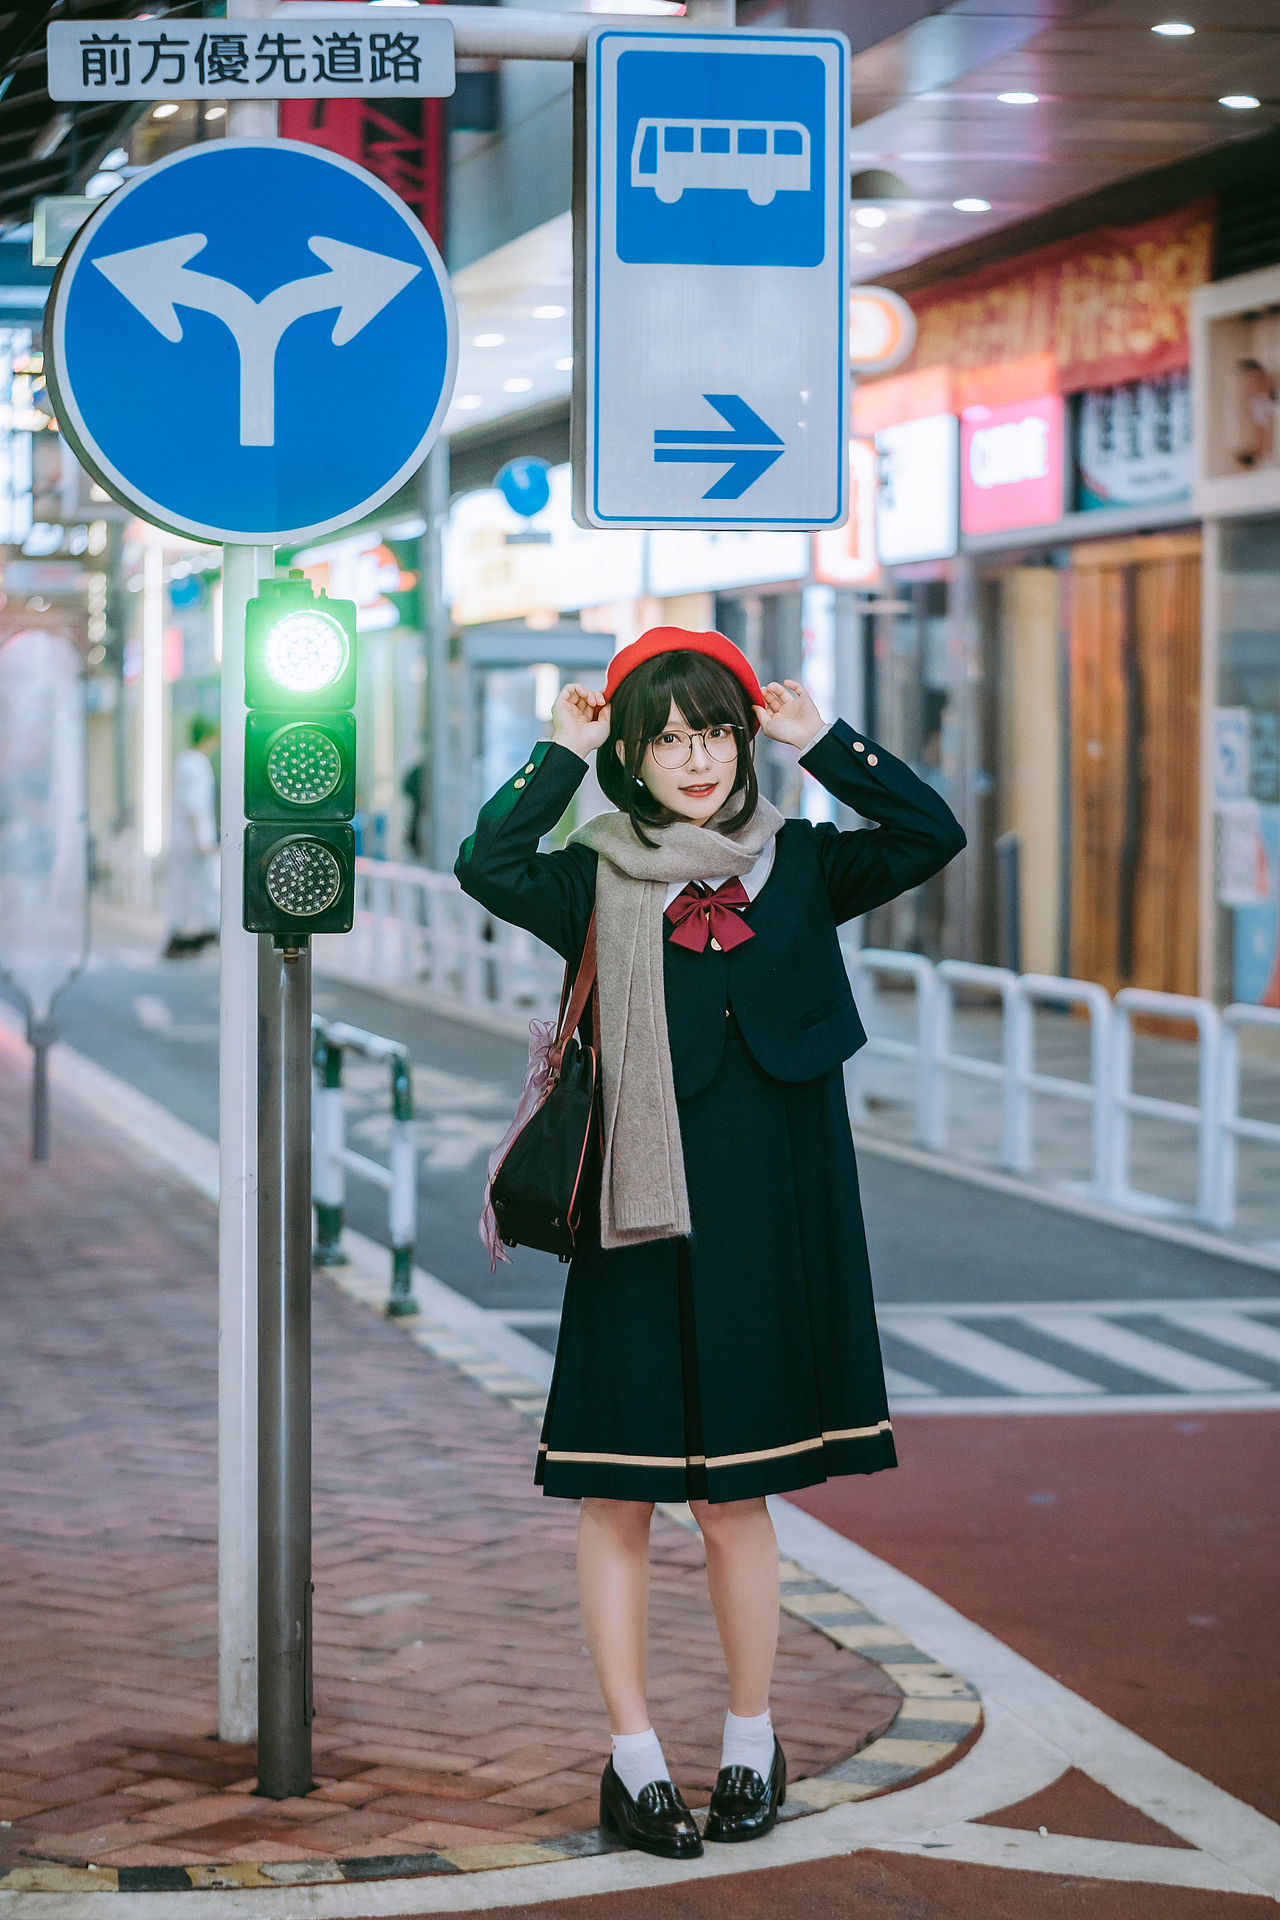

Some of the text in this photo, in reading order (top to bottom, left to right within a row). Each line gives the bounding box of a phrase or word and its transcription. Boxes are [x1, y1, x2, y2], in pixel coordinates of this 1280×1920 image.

[79, 32, 422, 86] 前方優先道路
